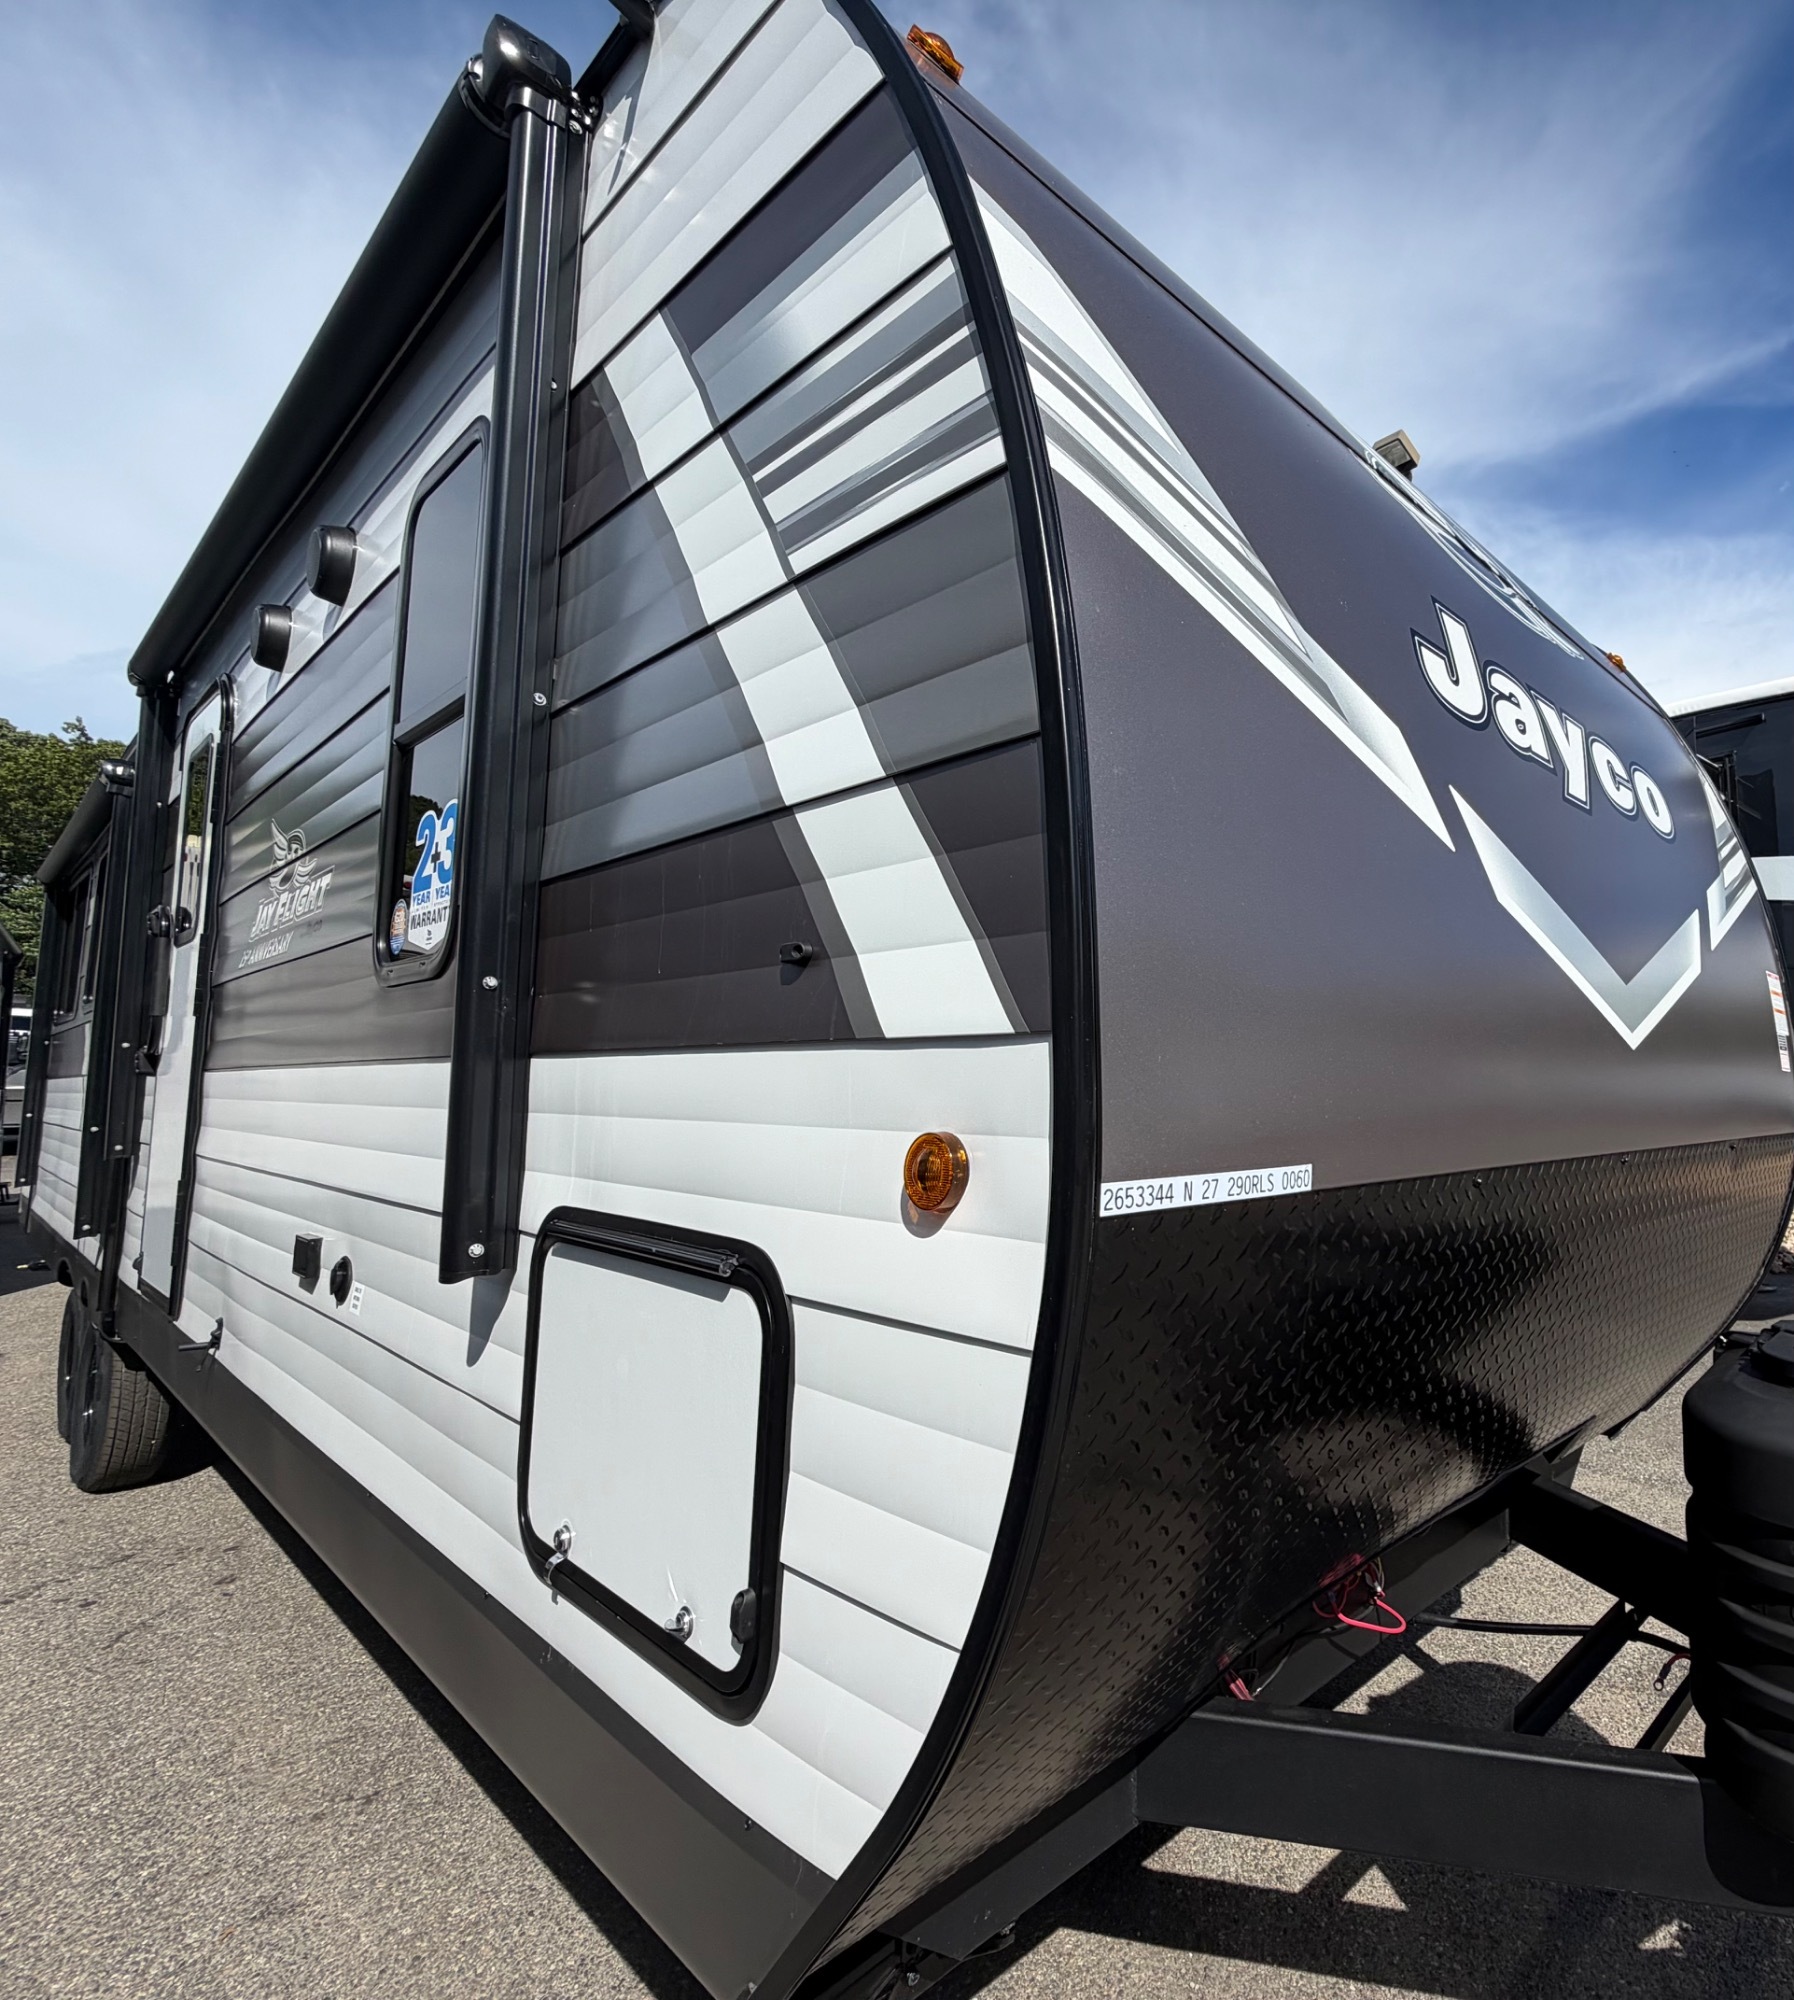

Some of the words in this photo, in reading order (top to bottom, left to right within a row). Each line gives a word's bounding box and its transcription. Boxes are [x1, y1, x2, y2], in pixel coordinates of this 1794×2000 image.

[1406, 596, 1675, 842] Jayco
[251, 900, 277, 939] JAY
[273, 873, 332, 924] FLIGHT
[412, 890, 431, 907] YEAR
[435, 885, 450, 900] YEA
[410, 906, 448, 930] WARRANT
[1103, 1183, 1174, 1211] 2653344
[1183, 1181, 1193, 1201] N
[1202, 1178, 1219, 1200] 27
[1227, 1172, 1274, 1197] 290RLS
[1282, 1168, 1310, 1190] 0060
